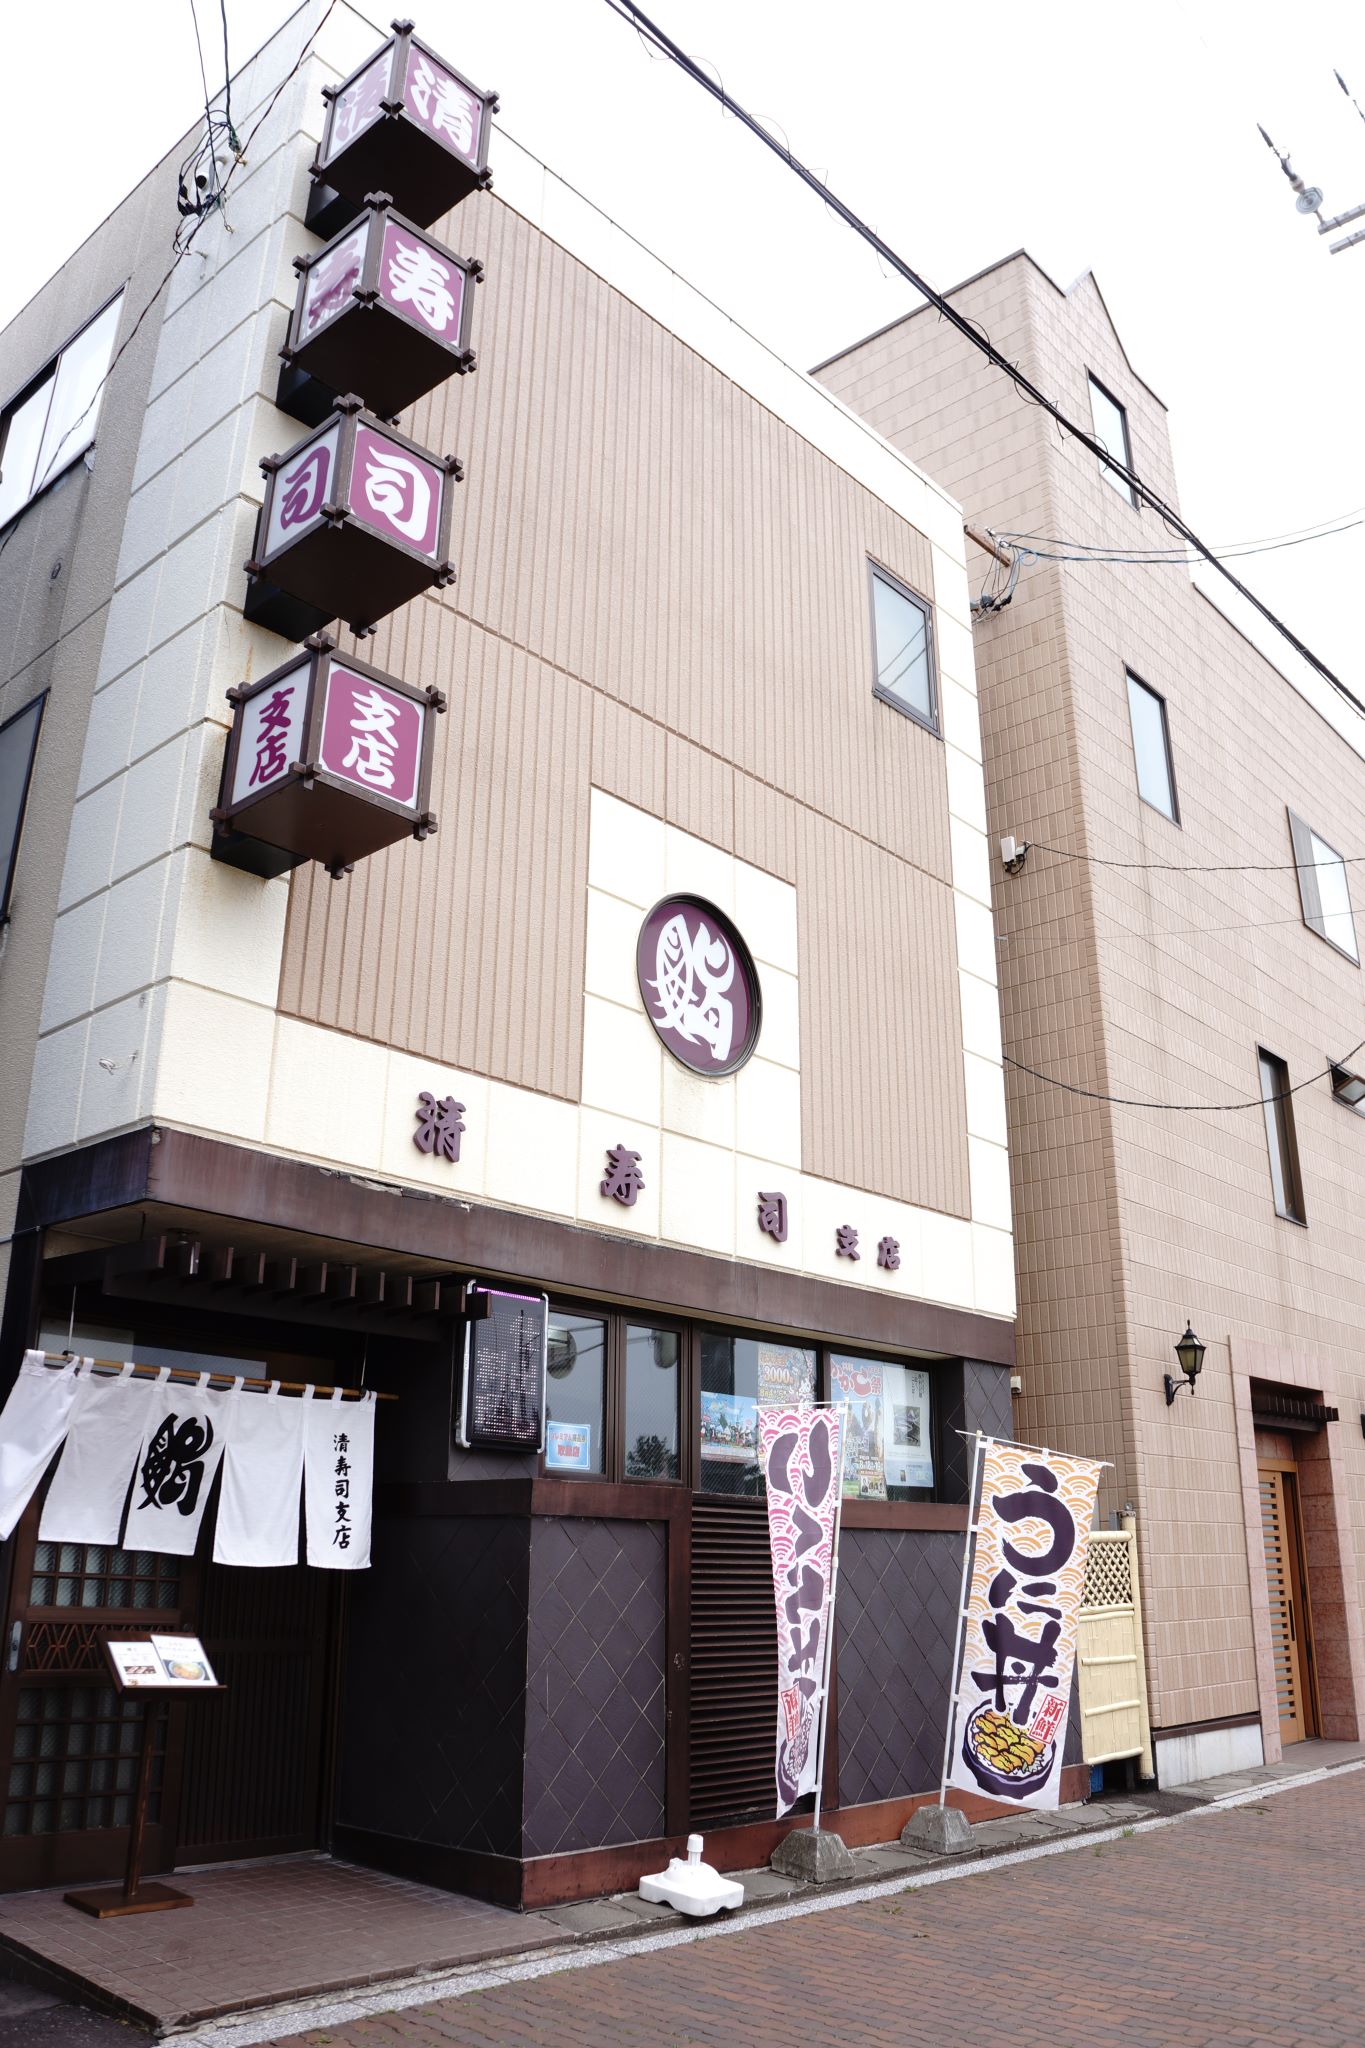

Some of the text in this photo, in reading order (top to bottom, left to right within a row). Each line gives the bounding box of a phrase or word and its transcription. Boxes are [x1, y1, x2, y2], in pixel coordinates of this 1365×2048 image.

[280, 445, 331, 531] 司
[365, 445, 432, 542] 司
[249, 687, 295, 787] 支店
[342, 689, 401, 790] 支店
[332, 1432, 352, 1550] 清寿司支店
[971, 1463, 1077, 1726] うに丼
[1030, 1697, 1064, 1741] 新鮮
